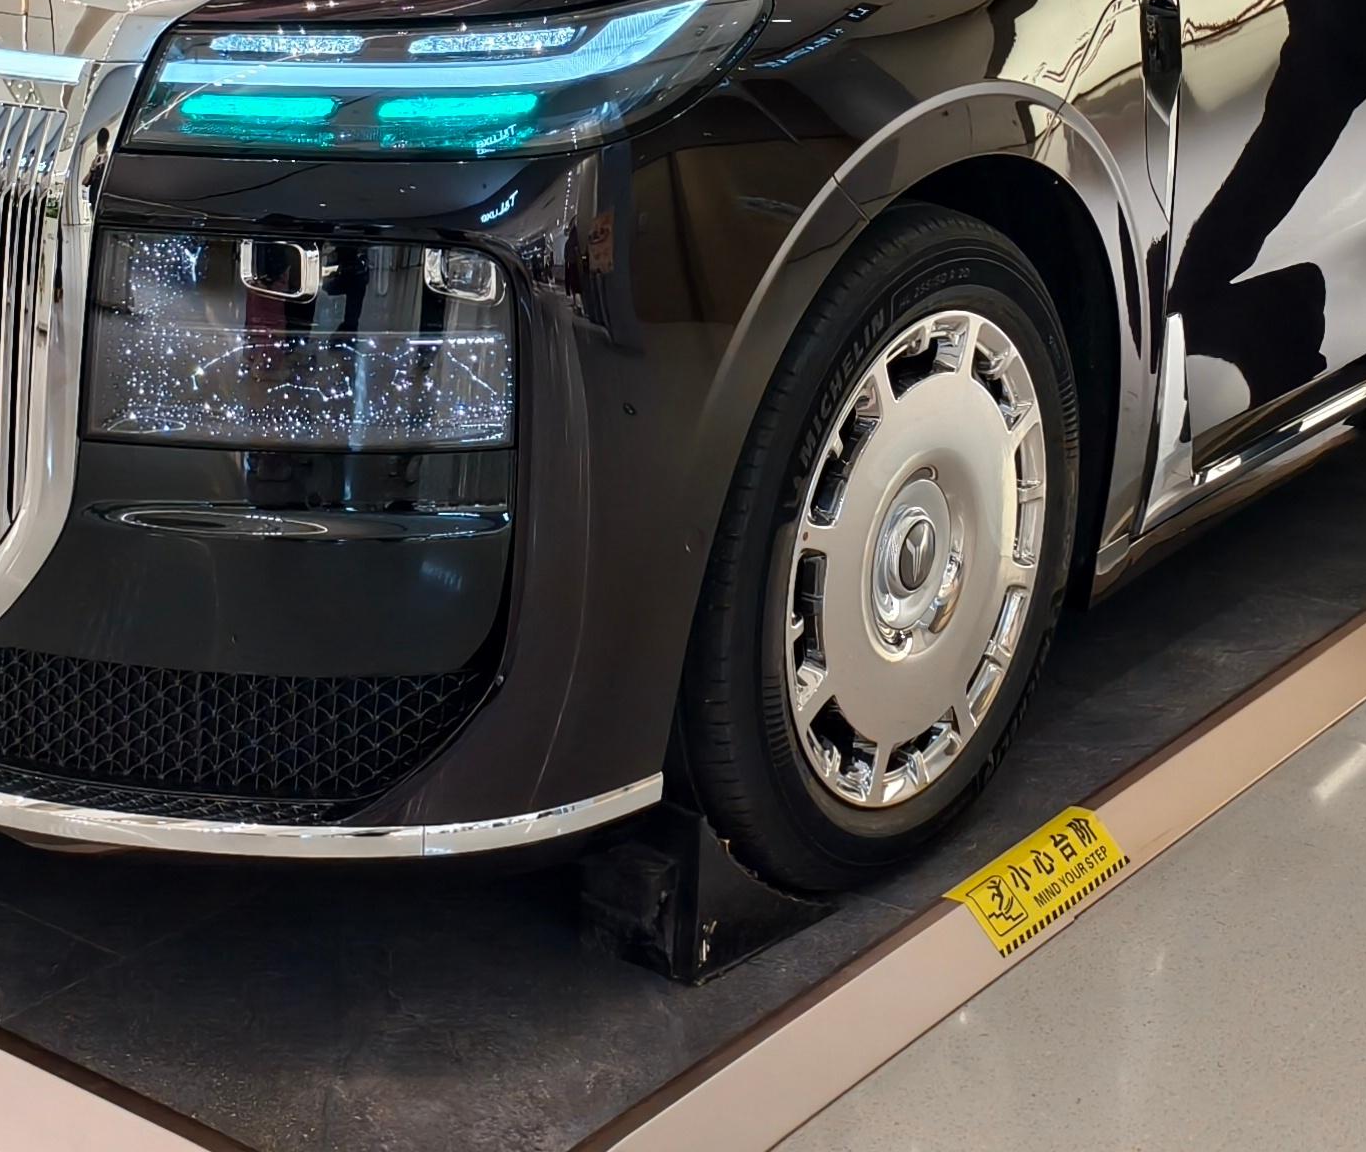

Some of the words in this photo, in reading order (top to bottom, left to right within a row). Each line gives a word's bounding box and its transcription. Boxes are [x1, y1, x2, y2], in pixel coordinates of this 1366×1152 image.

[798, 307, 886, 470] MICHELIN
[1007, 817, 1098, 892] 小心台阶
[1033, 881, 1062, 908] MIND
[1060, 862, 1088, 889] YOUR
[1086, 845, 1109, 869] STEP
